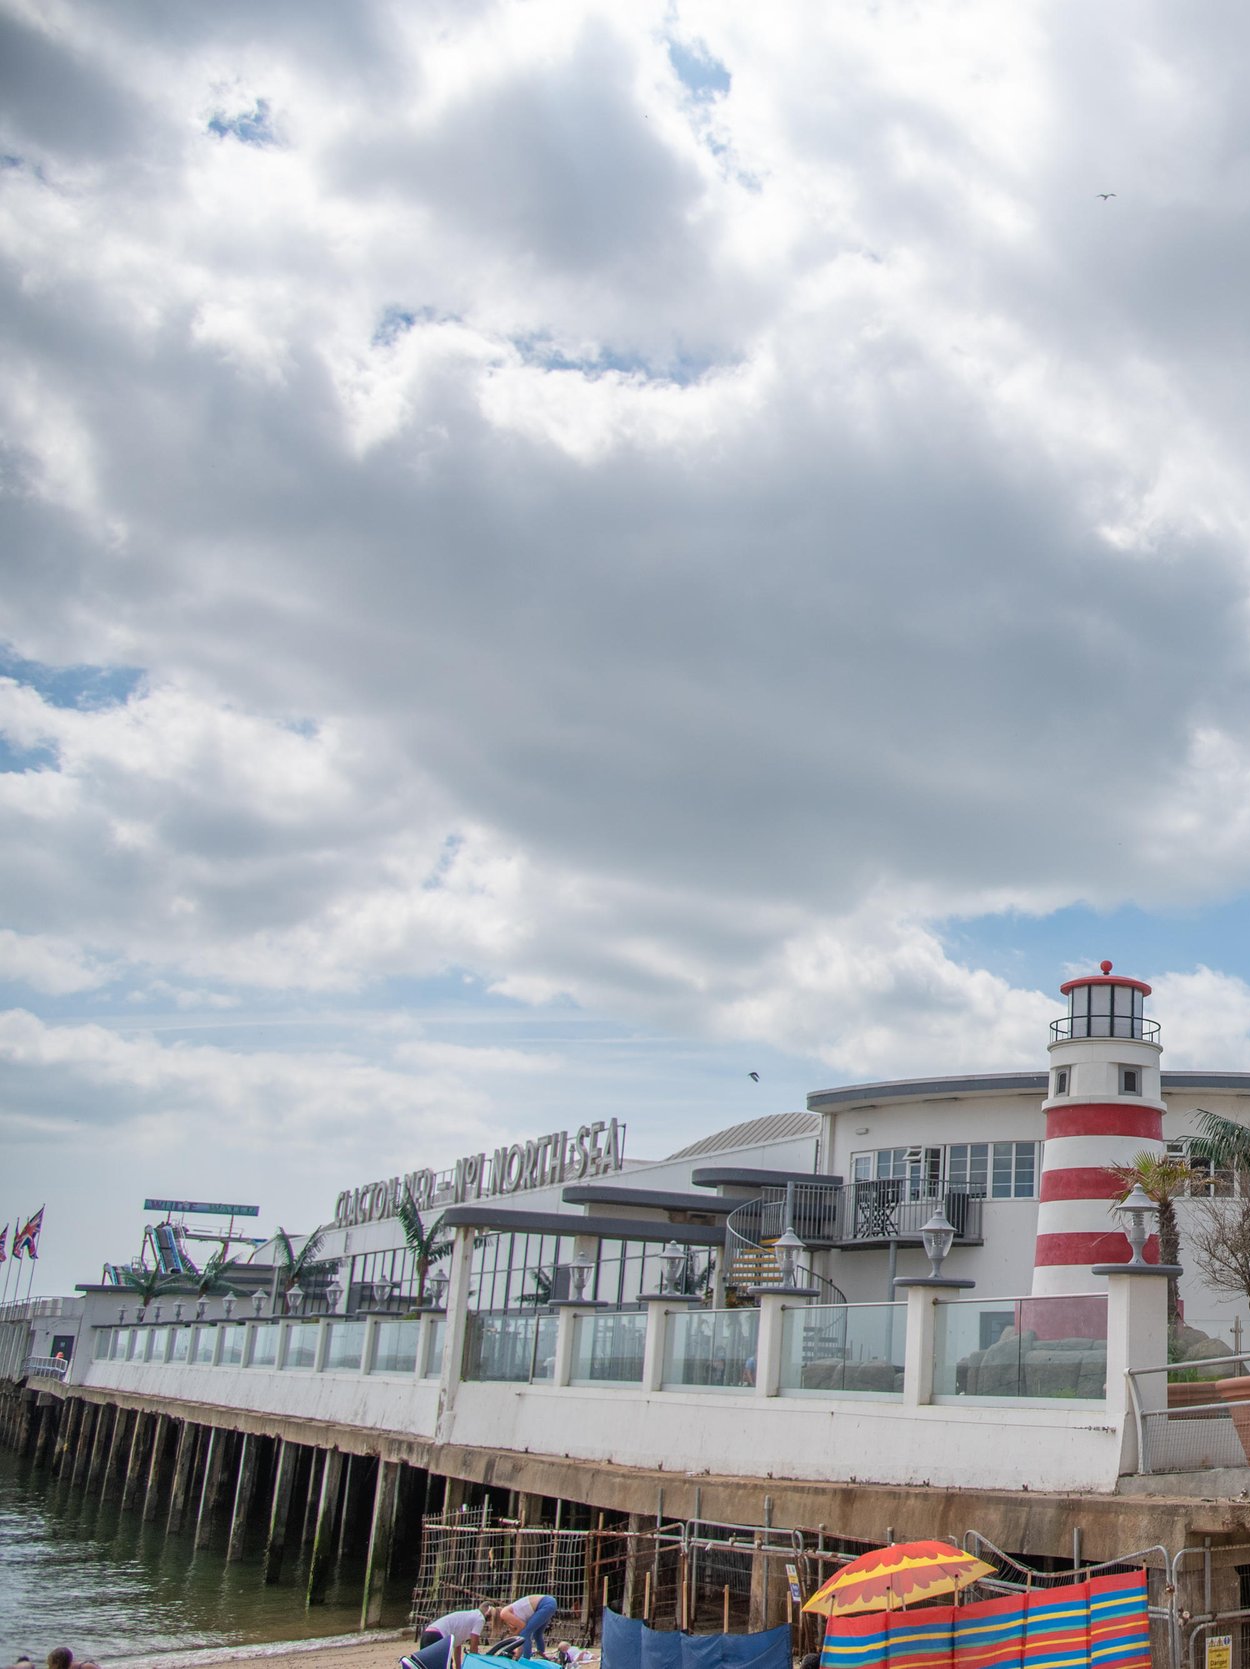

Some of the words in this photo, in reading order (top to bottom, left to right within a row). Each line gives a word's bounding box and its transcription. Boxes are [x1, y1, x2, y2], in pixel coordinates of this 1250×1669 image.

[334, 1177, 400, 1228] CLACTON
[491, 1131, 568, 1196] NORTH
[574, 1117, 620, 1178] SEA
